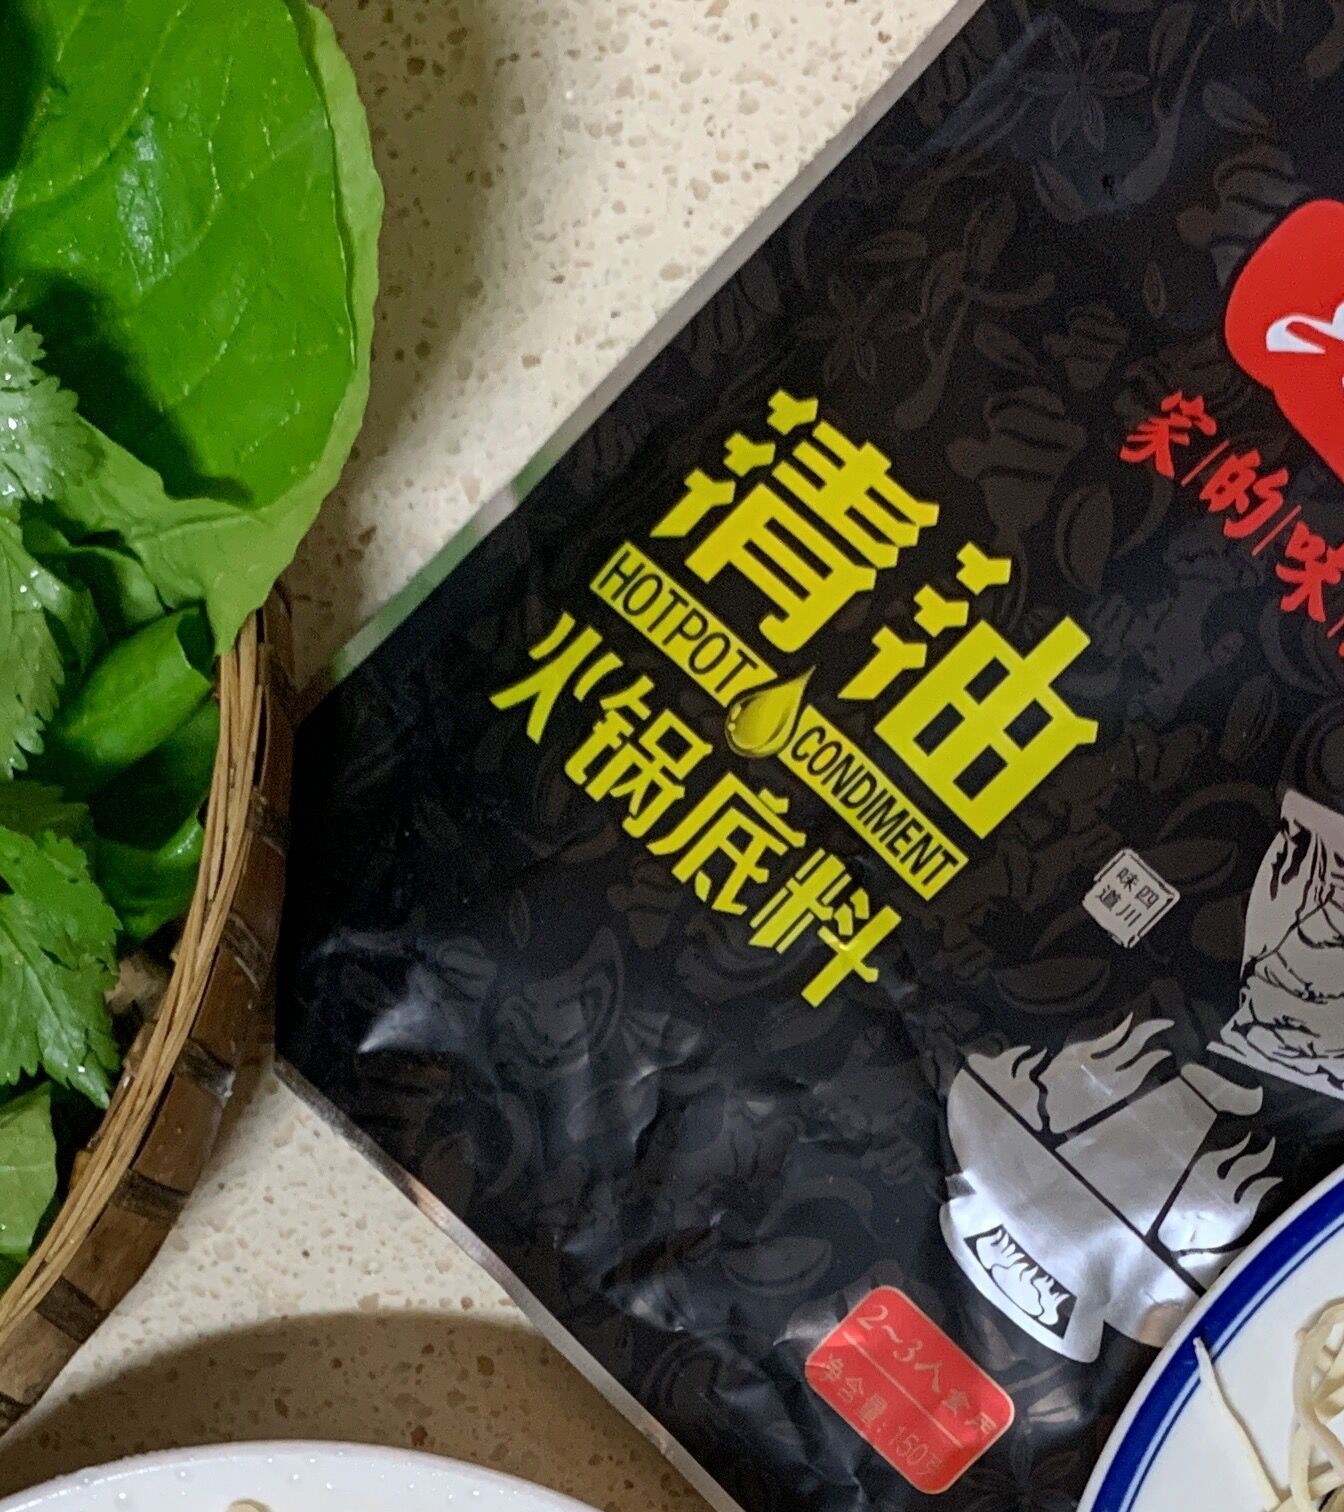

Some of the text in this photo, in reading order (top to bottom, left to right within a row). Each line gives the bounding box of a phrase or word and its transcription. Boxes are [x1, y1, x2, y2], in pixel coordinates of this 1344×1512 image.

[489, 611, 902, 1008] 火锅底料
[597, 548, 961, 887] HOTPOT CONDIMENT
[650, 389, 1099, 840] 清油
